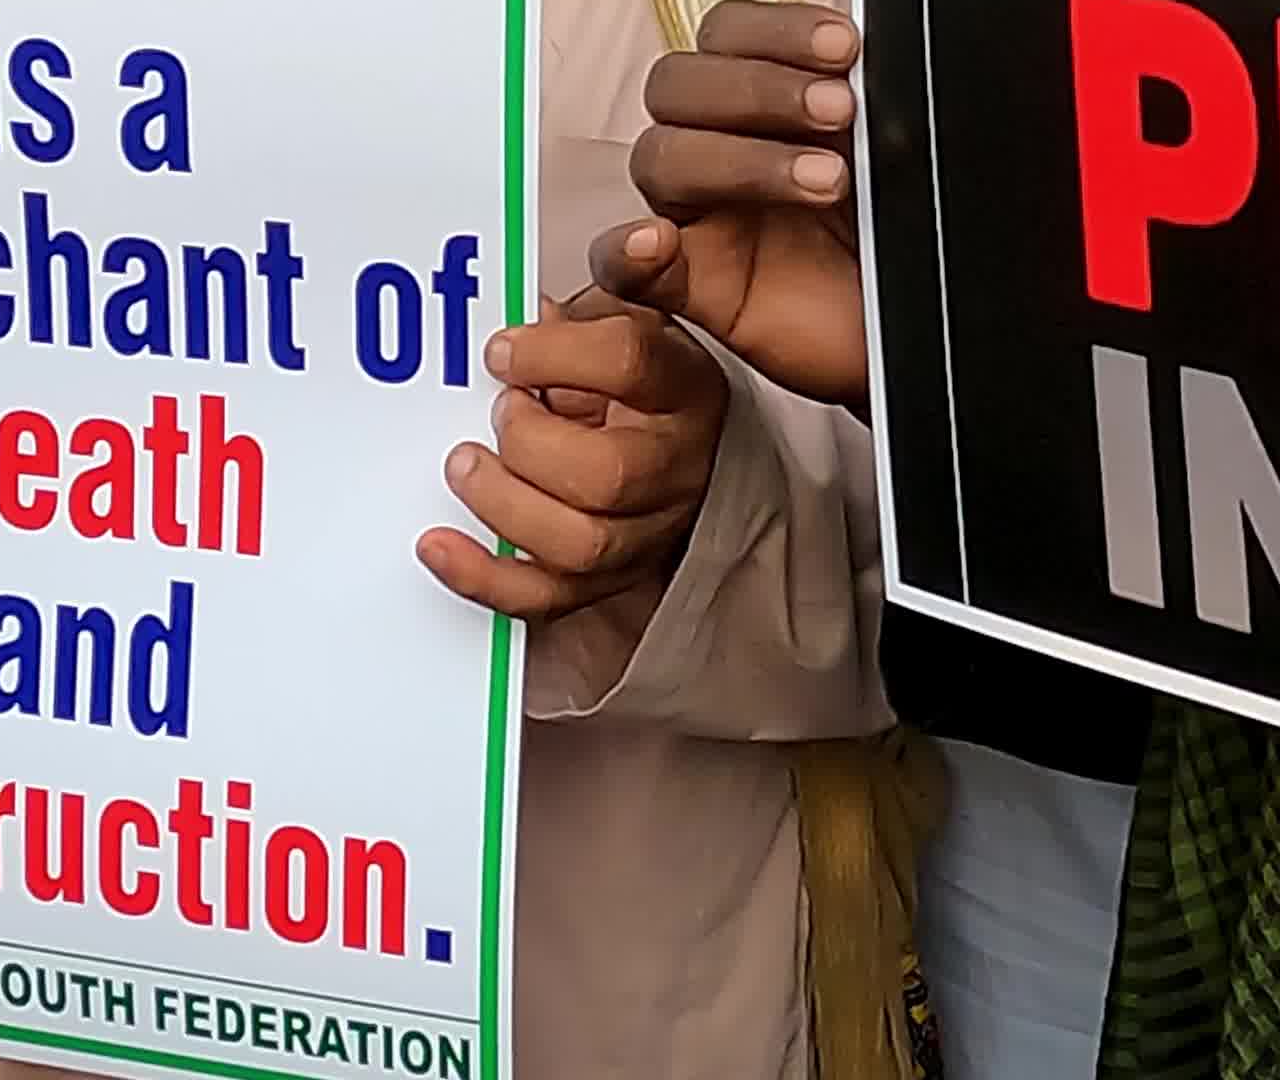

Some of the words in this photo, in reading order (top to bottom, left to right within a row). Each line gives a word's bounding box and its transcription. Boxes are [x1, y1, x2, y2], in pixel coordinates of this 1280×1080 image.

[119, 48, 192, 173] a
[356, 235, 479, 387] of
[153, 986, 473, 1080] FEDERATION
